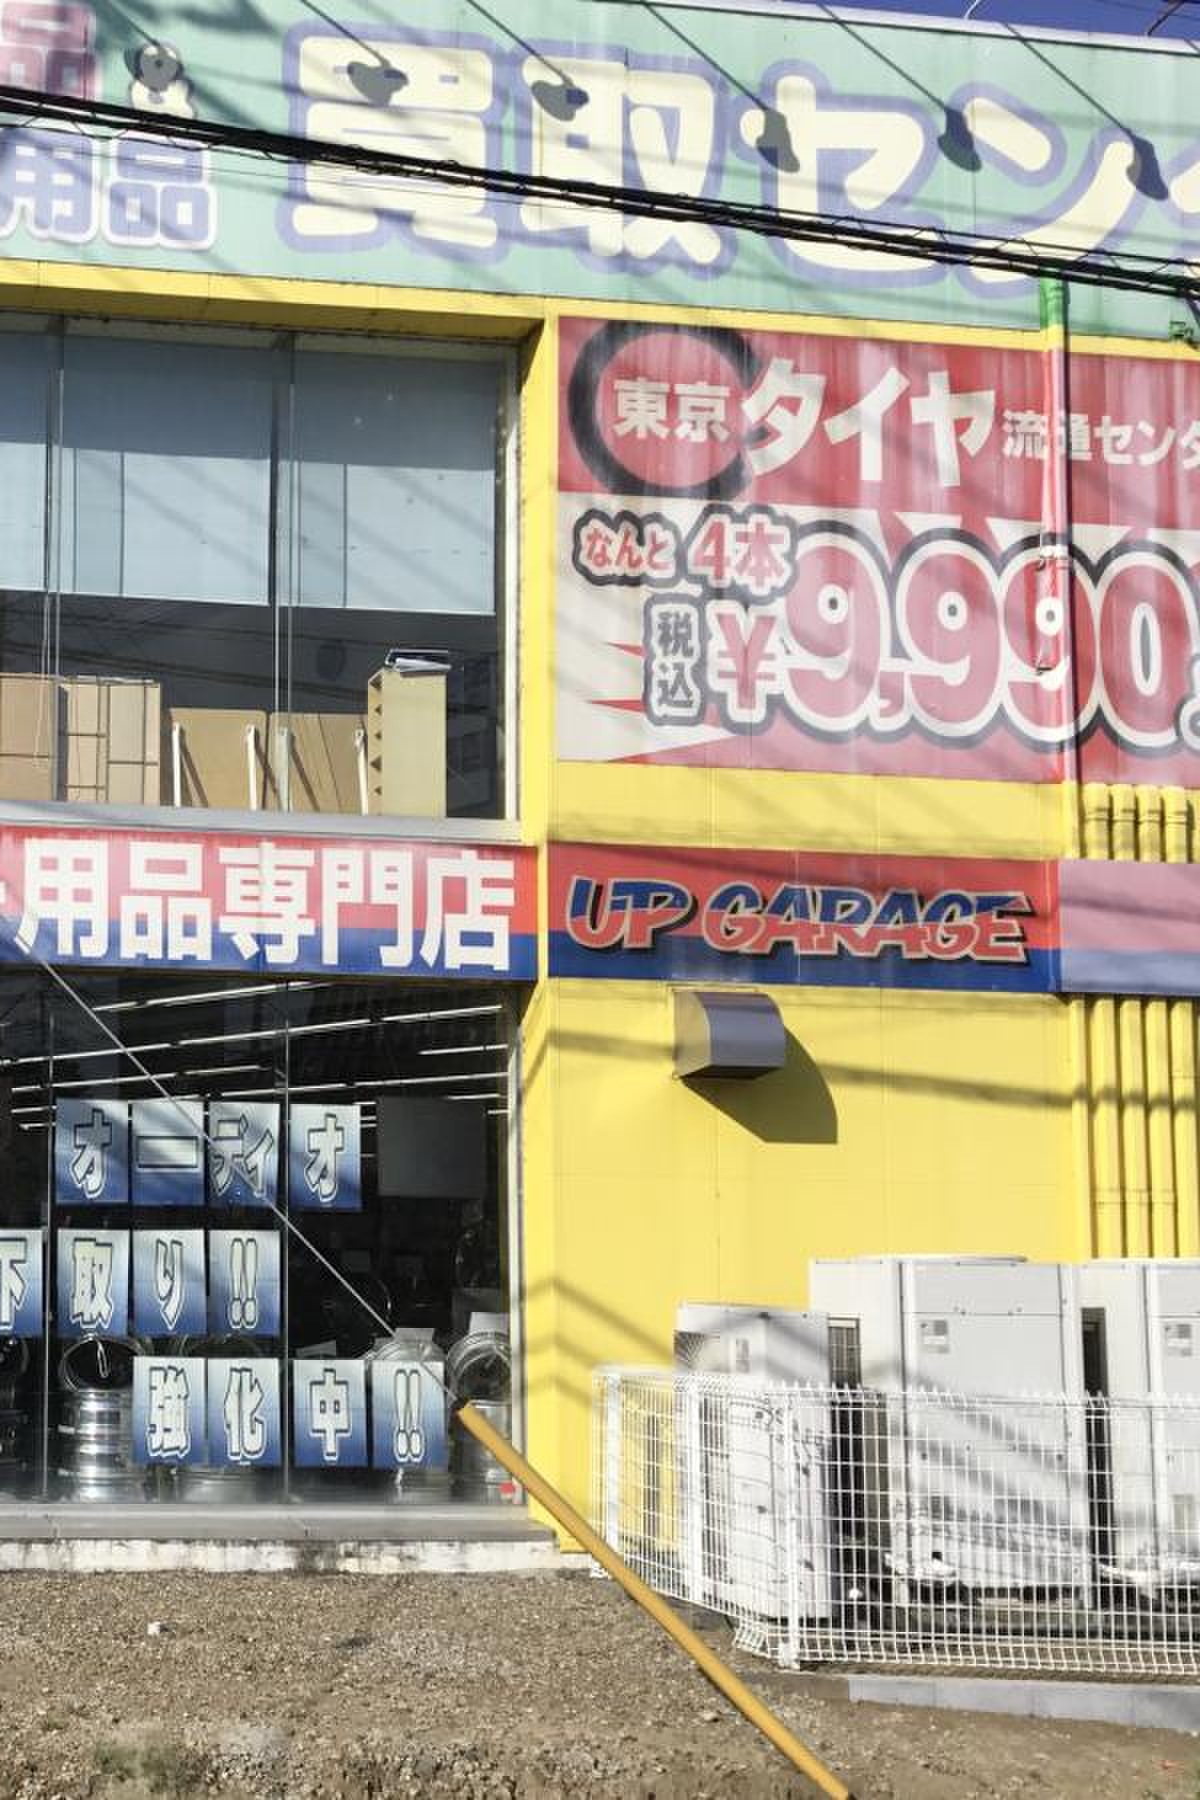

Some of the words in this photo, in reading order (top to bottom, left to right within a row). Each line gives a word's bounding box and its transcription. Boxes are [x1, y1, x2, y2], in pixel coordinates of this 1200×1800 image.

[290, 30, 1200, 292] 買取セン
[613, 377, 731, 443] 東京
[742, 357, 996, 487] タイヤ
[580, 521, 678, 578] なんと
[691, 516, 791, 588] 4本
[656, 608, 696, 711] 税込
[568, 875, 692, 950] UP
[701, 883, 1030, 964] GARAGE
[70, 1110, 347, 1203] オーディオ
[145, 1365, 424, 1461] 強化中!!
